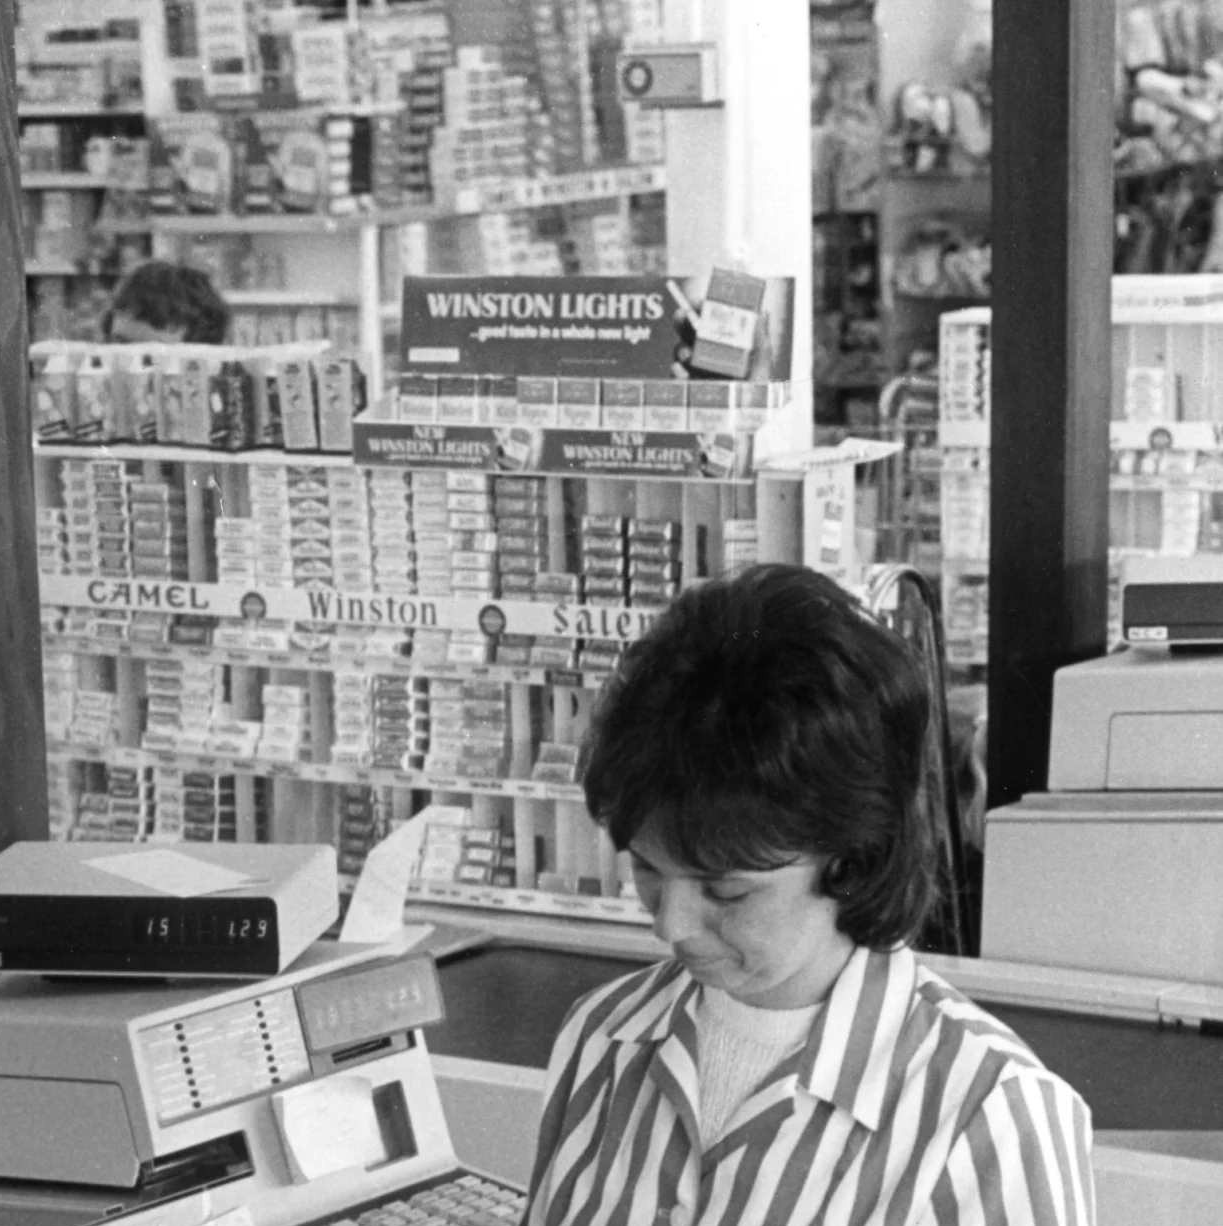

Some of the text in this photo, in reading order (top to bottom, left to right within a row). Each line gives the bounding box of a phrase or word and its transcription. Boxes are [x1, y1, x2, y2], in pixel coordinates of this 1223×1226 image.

[428, 292, 665, 320] WINSTON LIGHTS
[624, 325, 651, 345] light
[413, 427, 447, 440] NEW
[610, 432, 646, 446] NEW
[368, 438, 492, 456] WINSTON LIGHTS
[563, 445, 693, 463] WINSTON LIGHTS
[86, 579, 210, 611] CAMEL
[307, 590, 438, 627] Winston
[146, 917, 170, 937] 15
